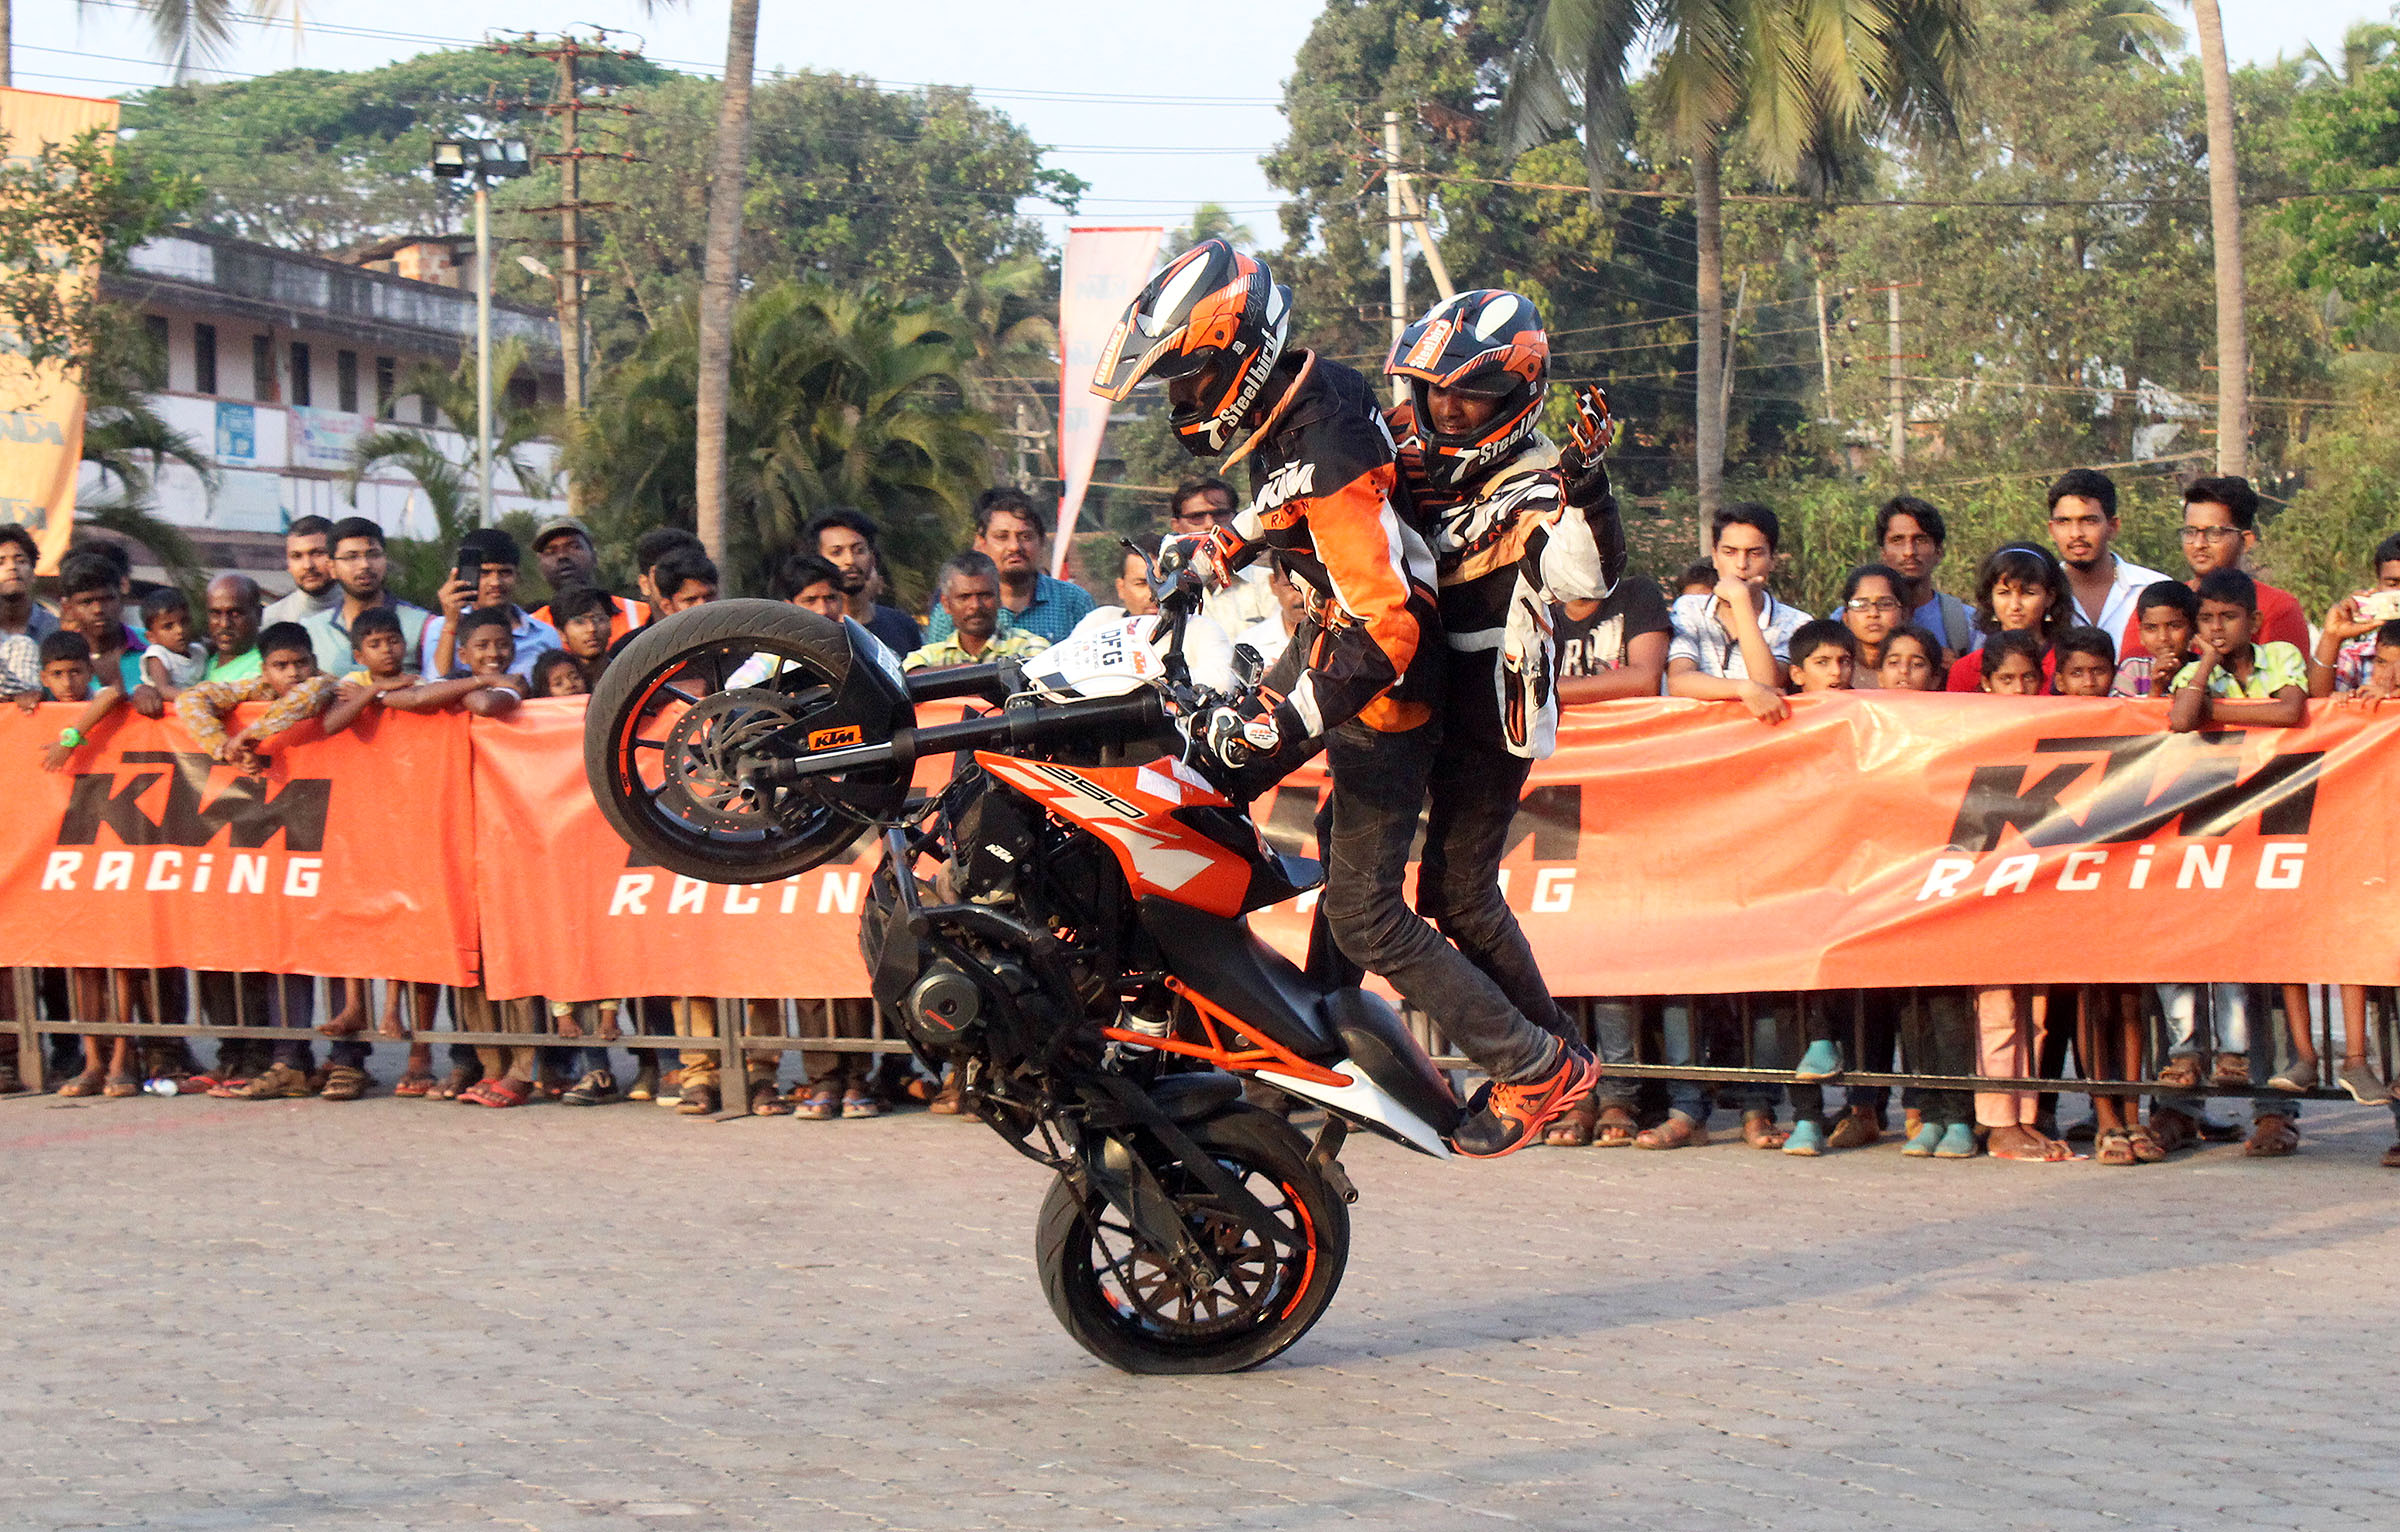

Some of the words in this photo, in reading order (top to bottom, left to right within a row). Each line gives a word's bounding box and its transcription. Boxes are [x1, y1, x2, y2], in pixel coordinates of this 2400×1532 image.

[1219, 327, 1277, 428] Steelbird
[1255, 458, 1316, 514] KTM
[815, 729, 855, 748] KTM
[56, 751, 333, 852] KTM
[1035, 764, 1146, 819] 250
[1945, 730, 2327, 852] KTM
